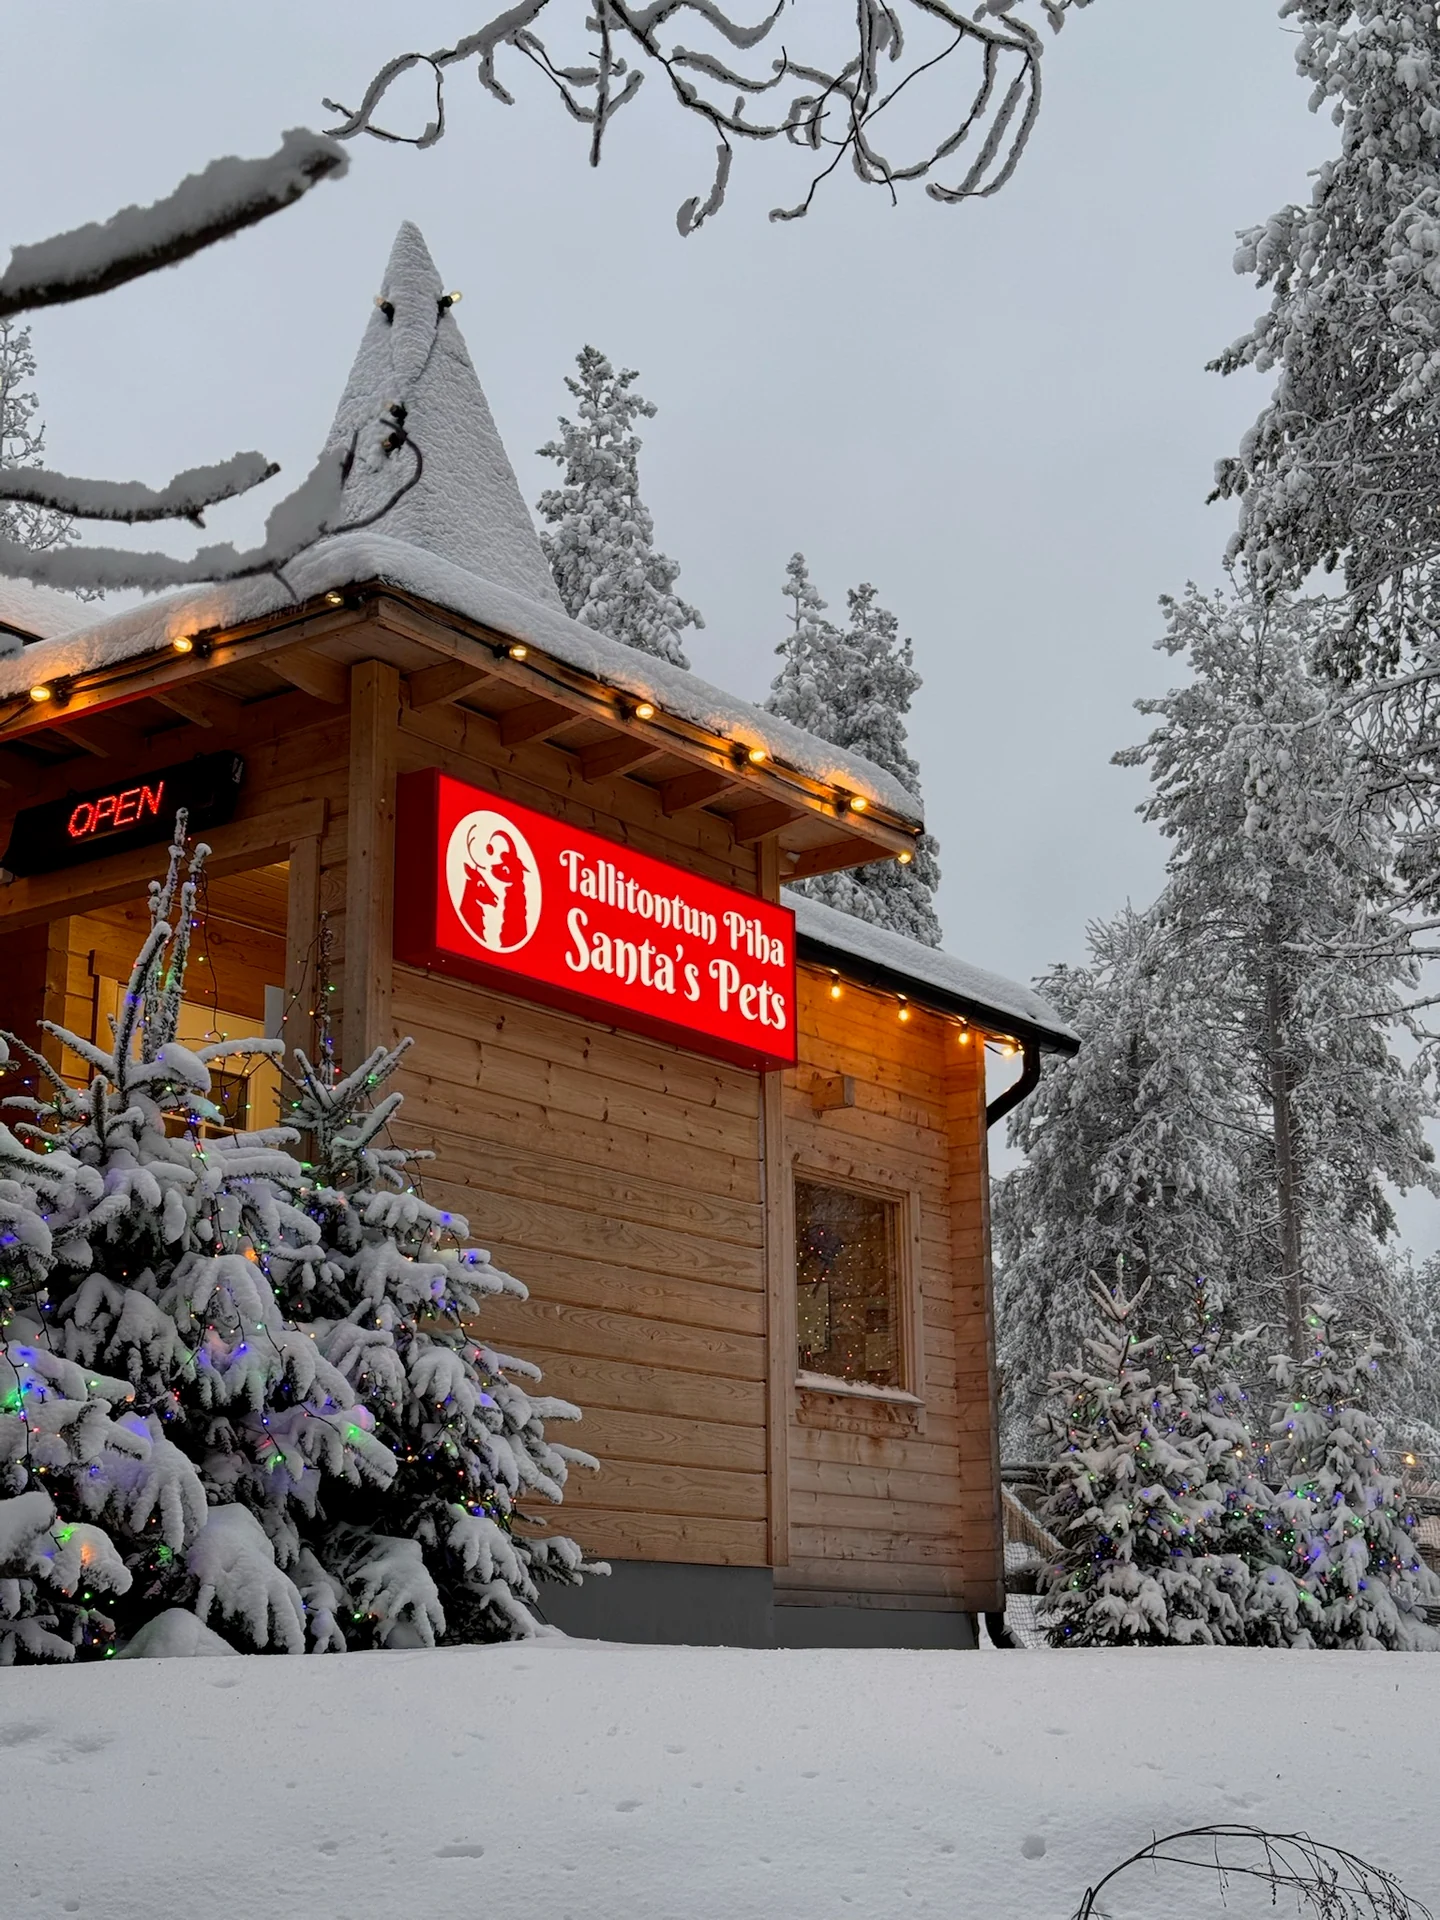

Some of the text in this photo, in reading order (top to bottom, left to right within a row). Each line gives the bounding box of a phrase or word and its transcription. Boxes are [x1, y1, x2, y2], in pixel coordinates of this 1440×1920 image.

[68, 781, 164, 838] OPEN
[559, 849, 786, 968] Tallitontun Piha
[709, 959, 787, 1031] Pets
